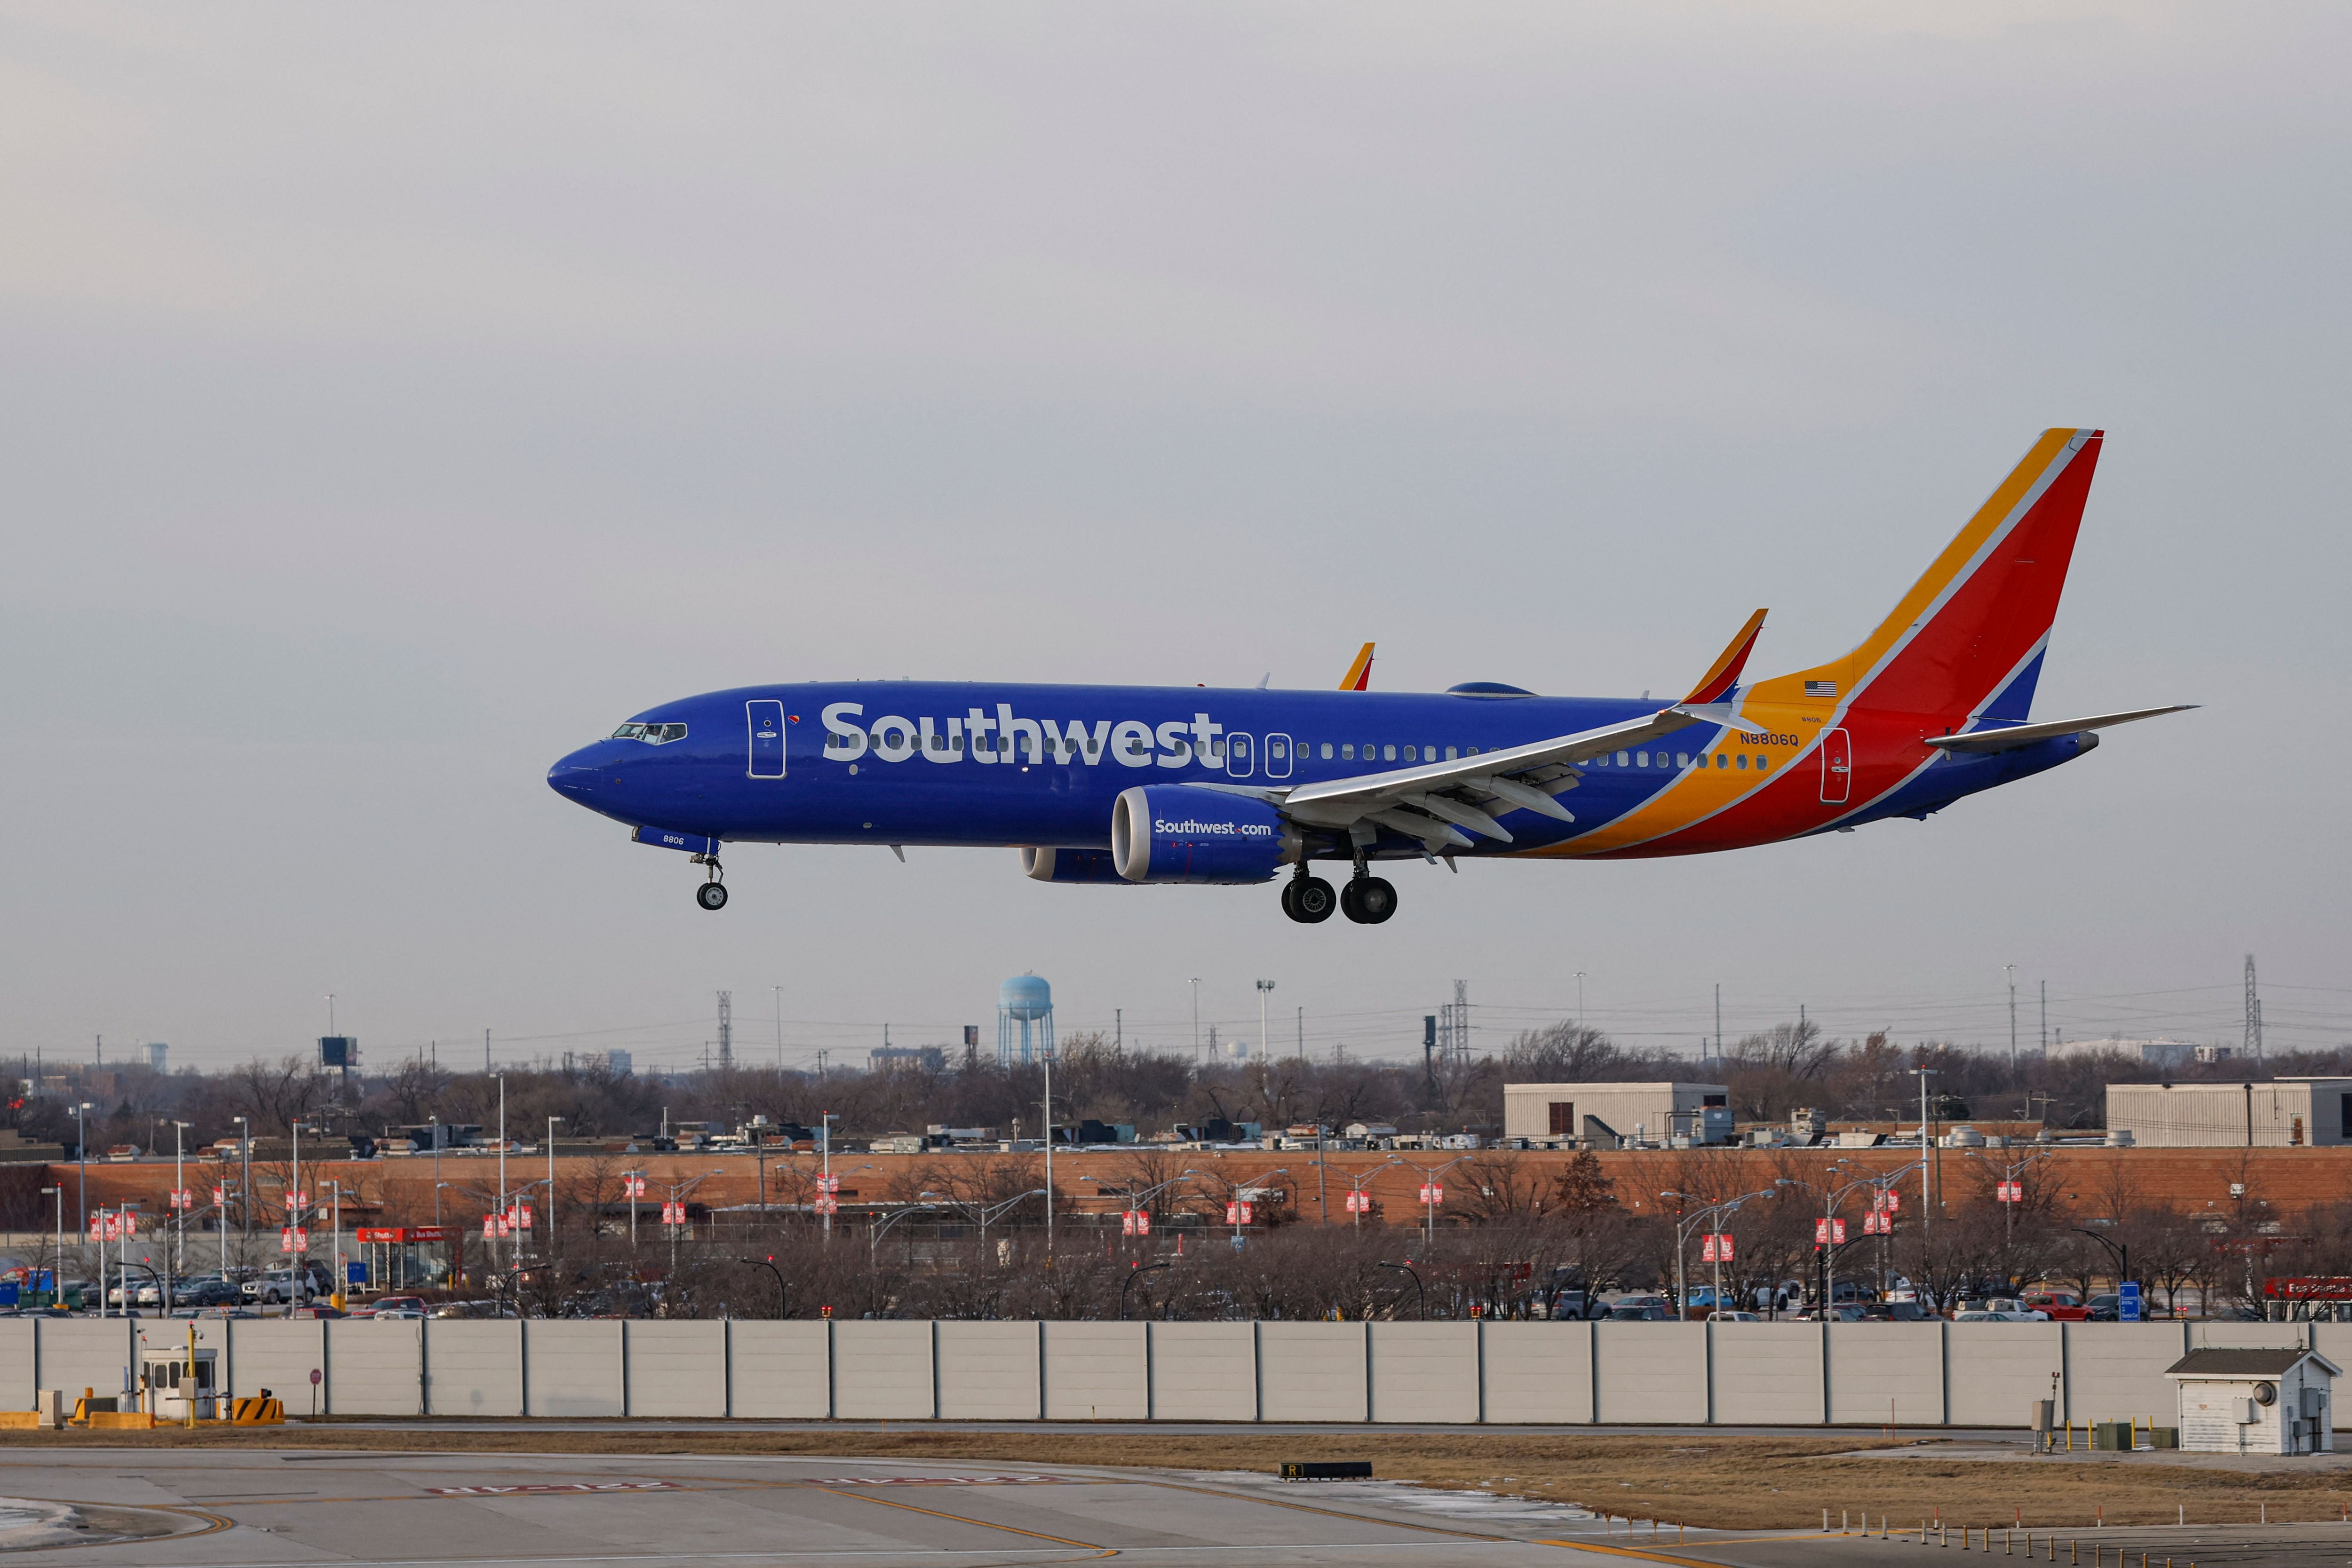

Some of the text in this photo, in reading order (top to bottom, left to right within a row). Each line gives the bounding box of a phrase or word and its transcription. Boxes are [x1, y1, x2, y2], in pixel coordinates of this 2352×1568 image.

[821, 702, 1224, 768] Southwest
[1740, 733, 1798, 747] N8806Q
[663, 835, 684, 845] 8806
[676, 1208, 684, 1216] D7
[1241, 1207, 1250, 1216] D7
[499, 1220, 507, 1228] D5
[1138, 1218, 1147, 1227] D5
[297, 1234, 305, 1243] D3
[1289, 1465, 1296, 1475] R
